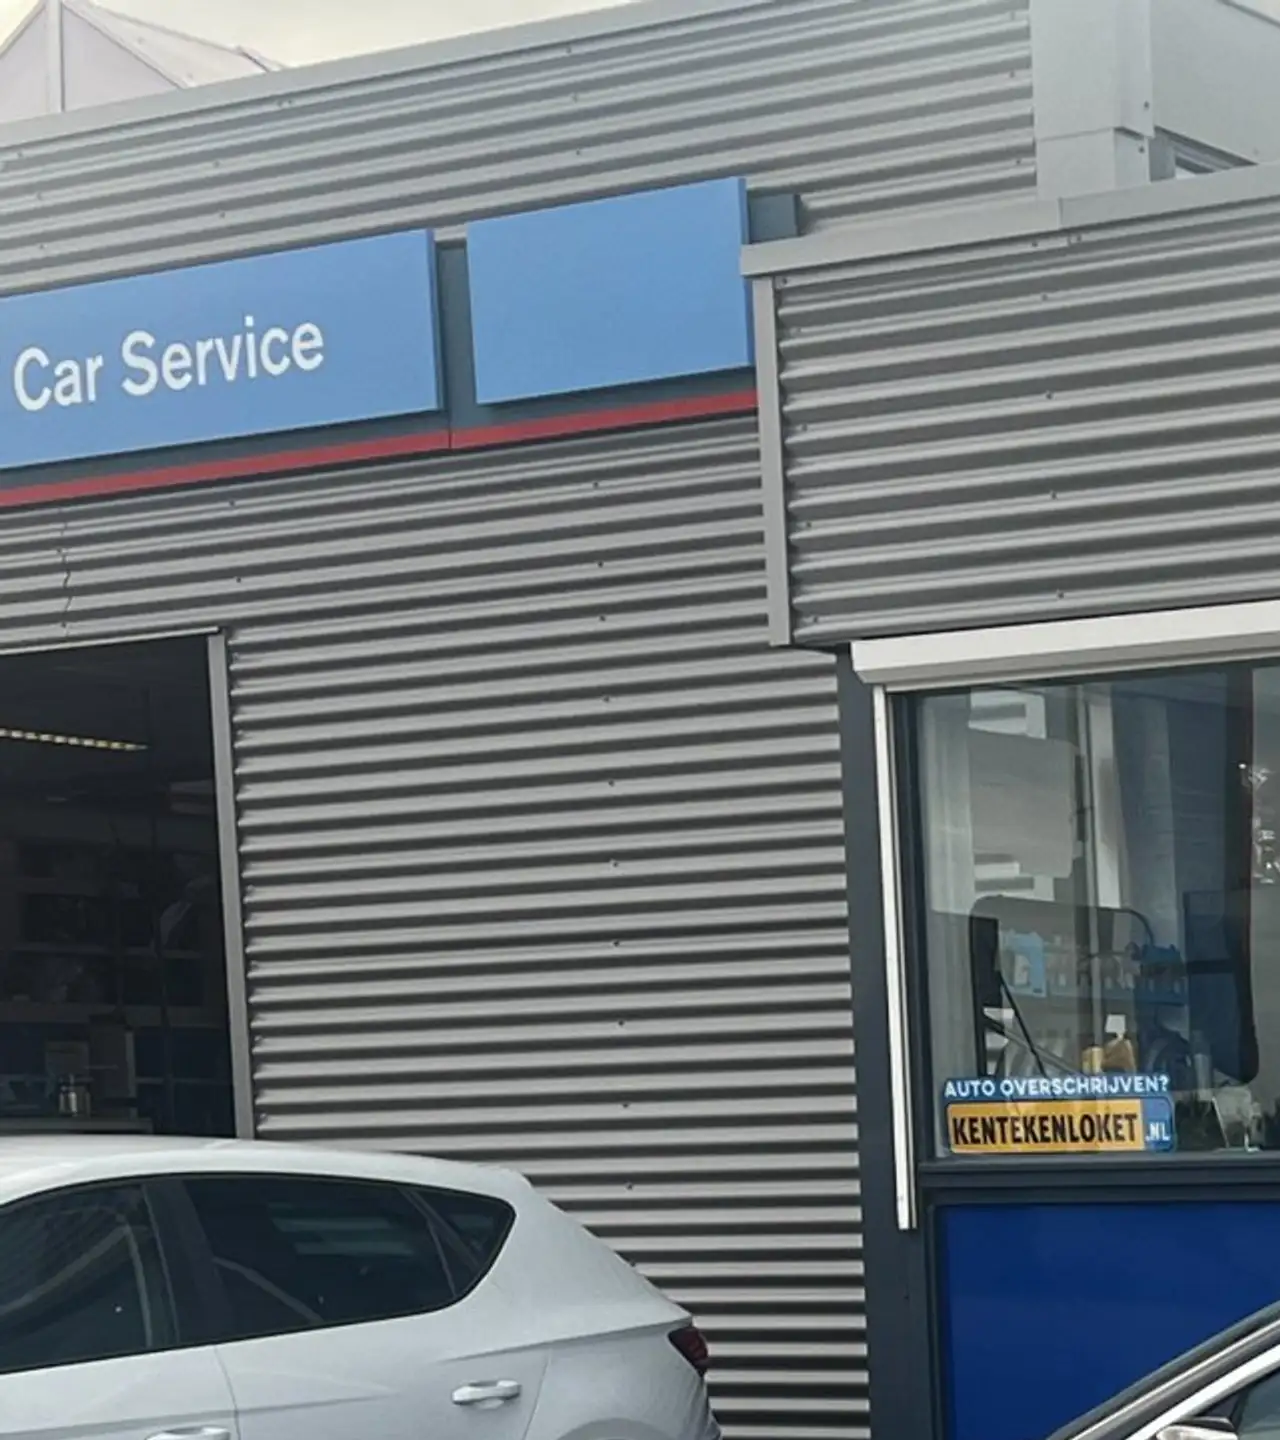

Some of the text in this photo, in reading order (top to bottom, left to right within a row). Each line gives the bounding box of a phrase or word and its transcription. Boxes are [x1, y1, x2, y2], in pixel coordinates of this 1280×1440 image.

[13, 314, 326, 413] Car Service
[944, 1075, 1170, 1098] AUTO OVERSCHRIJVEN?
